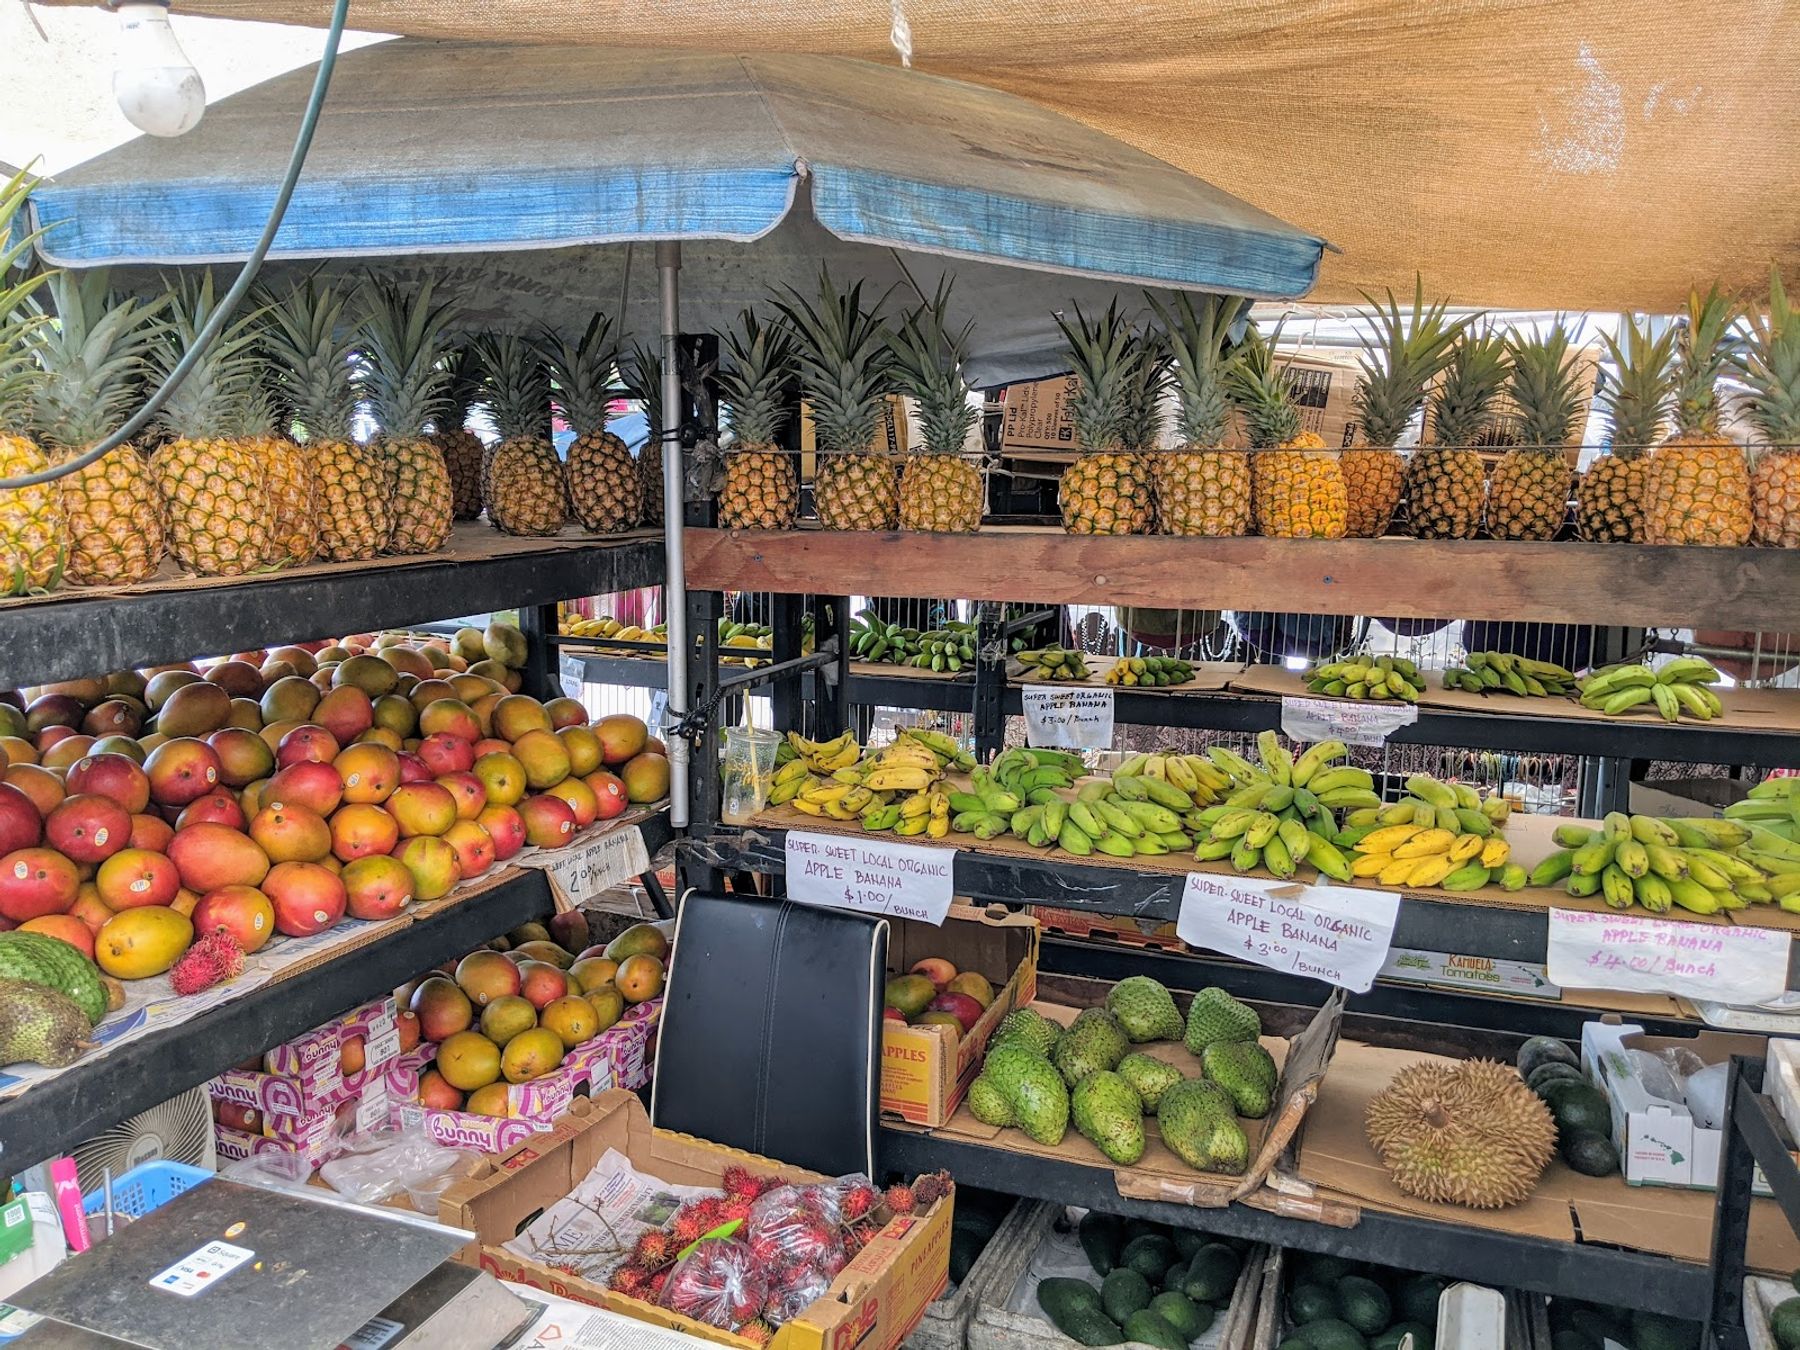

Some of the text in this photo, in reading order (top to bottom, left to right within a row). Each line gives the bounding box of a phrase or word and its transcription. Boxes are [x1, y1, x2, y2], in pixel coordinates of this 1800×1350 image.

[1009, 407, 1018, 422] Lid
[1024, 693, 1047, 701] SUPER
[1050, 692, 1075, 700] SWEET
[1040, 701, 1107, 711] APPLE BANANA
[825, 844, 857, 862] SWEET
[862, 851, 894, 869] LOCAL
[898, 857, 949, 877] ORGANIC
[804, 859, 903, 889] APPLE BANANA
[894, 905, 929, 920] BUNCH
[1230, 888, 1266, 909] SWEET
[1270, 900, 1306, 922] LOCAL
[1314, 914, 1373, 942] ORGANIC
[1226, 908, 1338, 952] APPLE BANANA
[1553, 910, 1597, 924] SUPER
[1699, 923, 1767, 941] ORGANIC
[1602, 928, 1725, 952] APPLE BANANA
[1440, 964, 1501, 983] Tomatoes
[882, 1045, 927, 1063] PPLES
